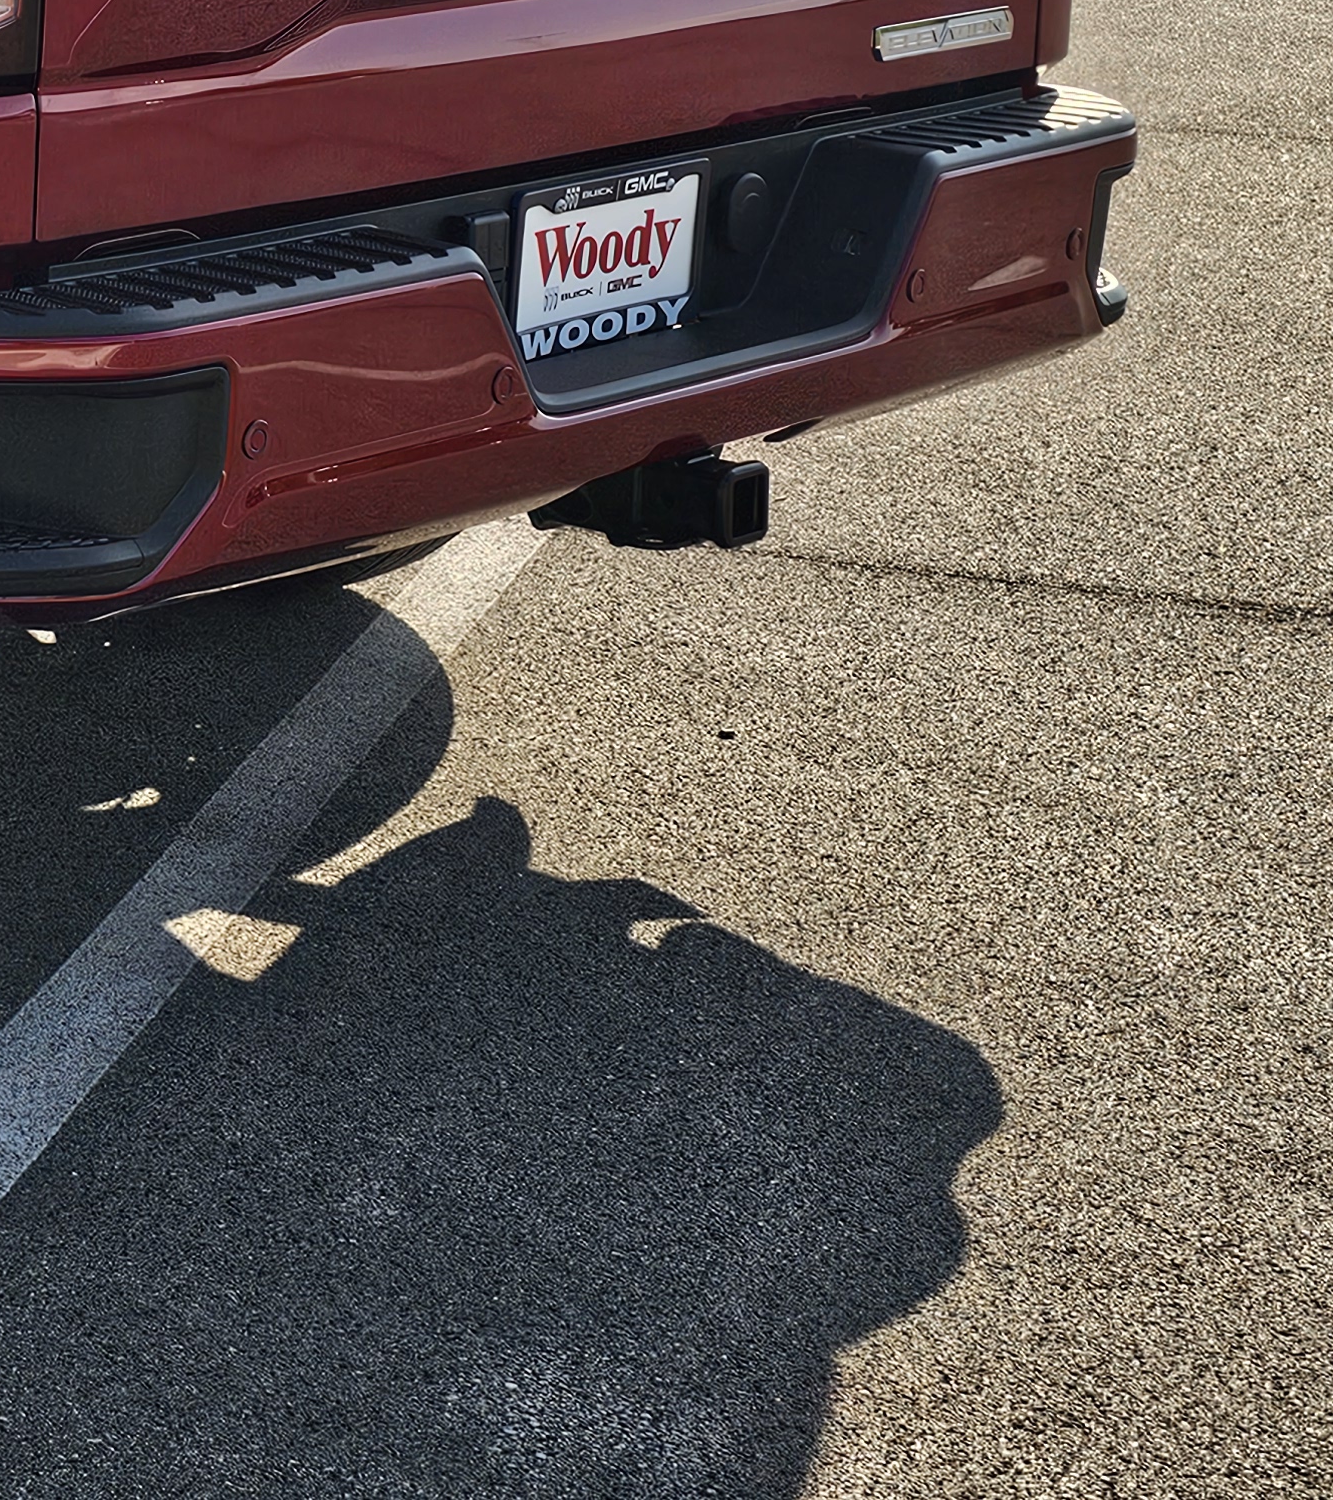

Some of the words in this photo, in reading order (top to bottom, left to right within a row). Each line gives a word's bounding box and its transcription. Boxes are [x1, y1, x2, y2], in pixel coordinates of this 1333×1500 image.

[581, 186, 614, 200] BUICK
[624, 171, 669, 195] GMC
[534, 209, 682, 287] Woody
[606, 274, 643, 294] GMC
[520, 296, 690, 361] WOODY
